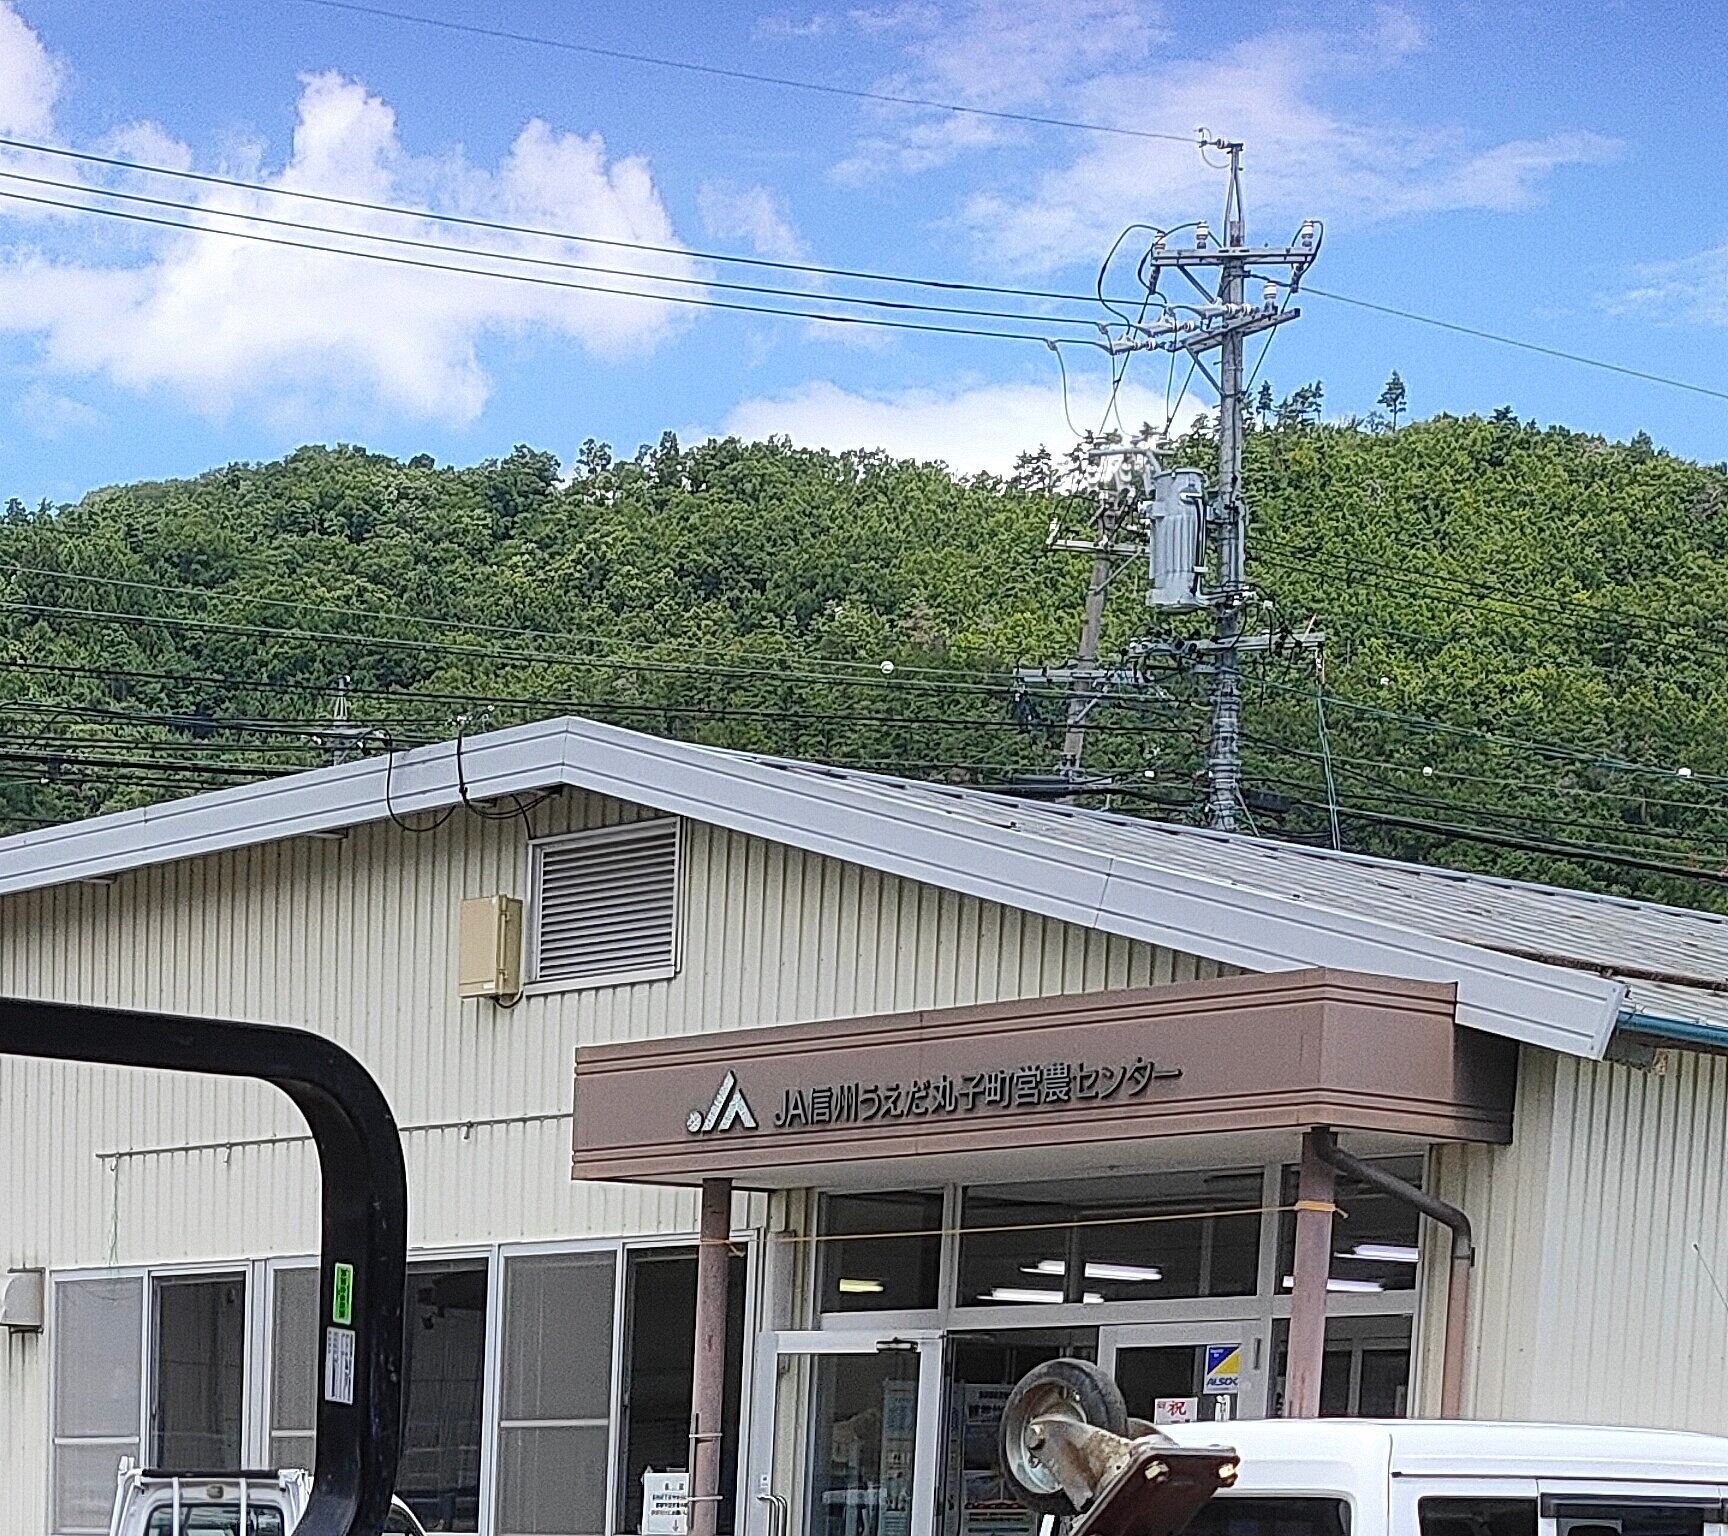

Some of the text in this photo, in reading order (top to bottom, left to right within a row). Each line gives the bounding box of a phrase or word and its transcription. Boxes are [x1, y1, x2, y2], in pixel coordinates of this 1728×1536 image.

[774, 1056, 1184, 1128] JA信州うえだ丸子町営農センター
